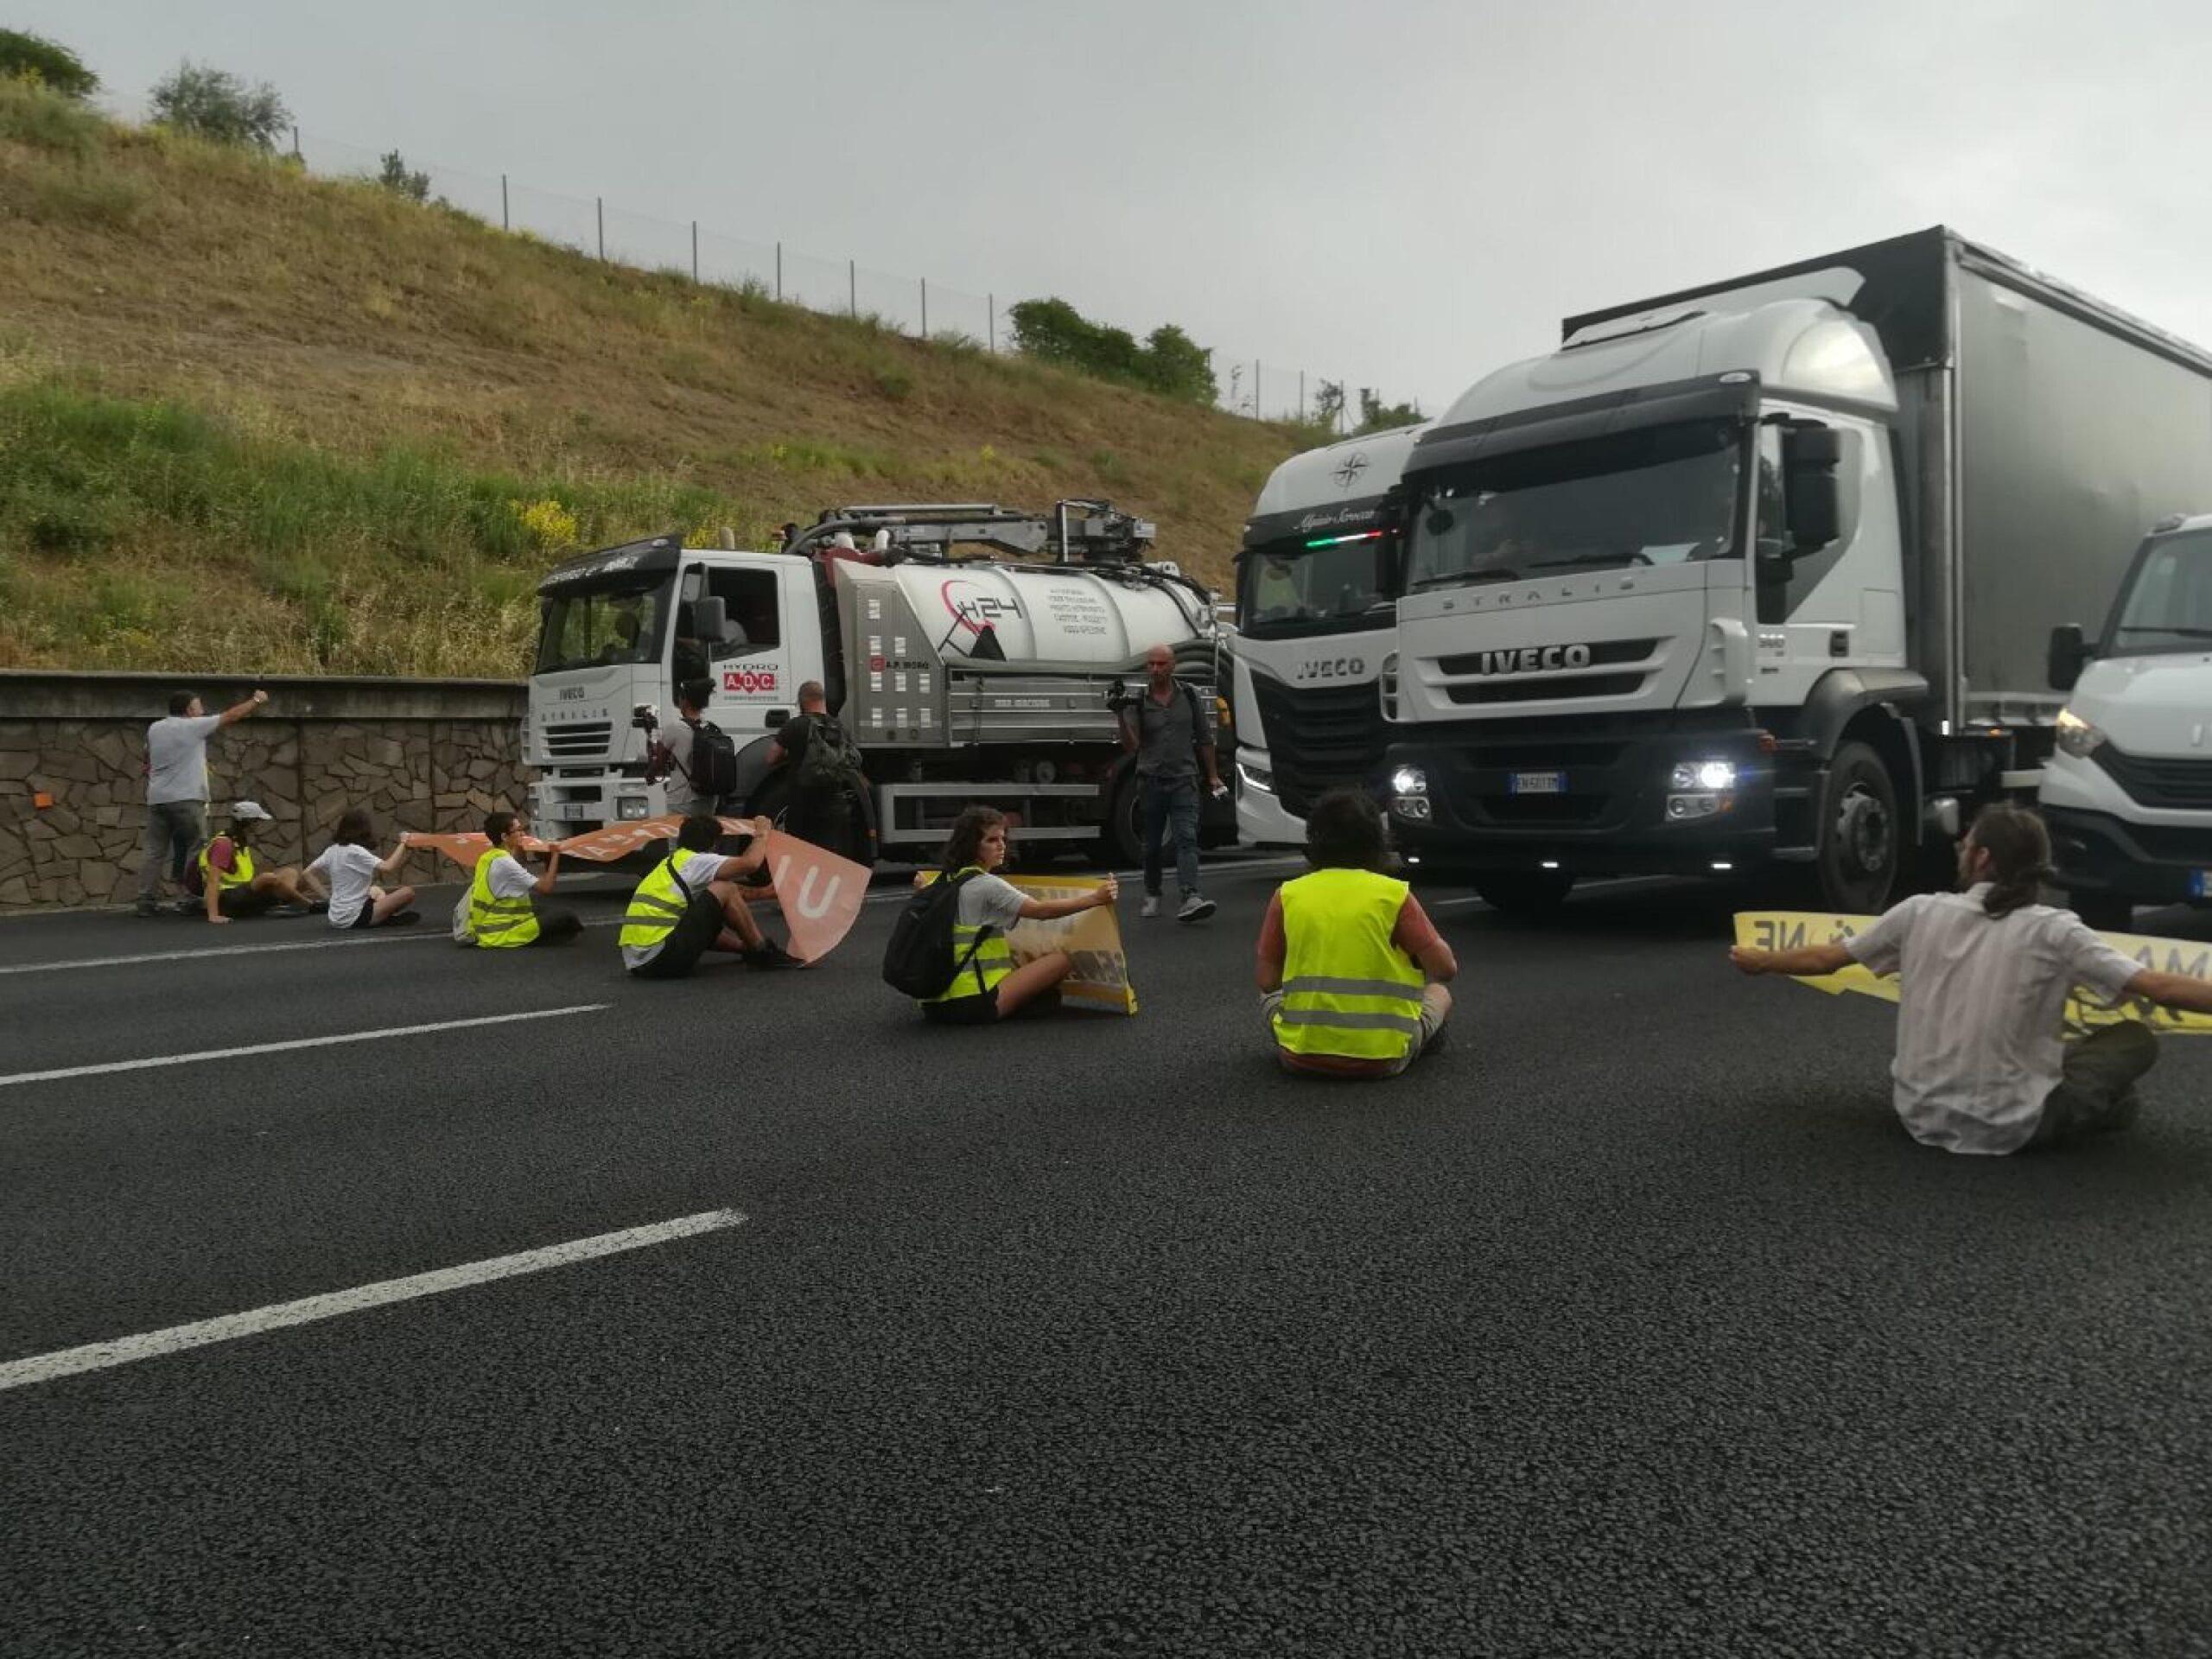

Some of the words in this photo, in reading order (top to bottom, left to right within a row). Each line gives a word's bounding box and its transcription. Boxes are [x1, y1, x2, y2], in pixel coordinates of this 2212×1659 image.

[1442, 576, 1634, 609] STRALIS
[1296, 658, 1365, 680] IVECO
[1480, 644, 1591, 676] IVECO
